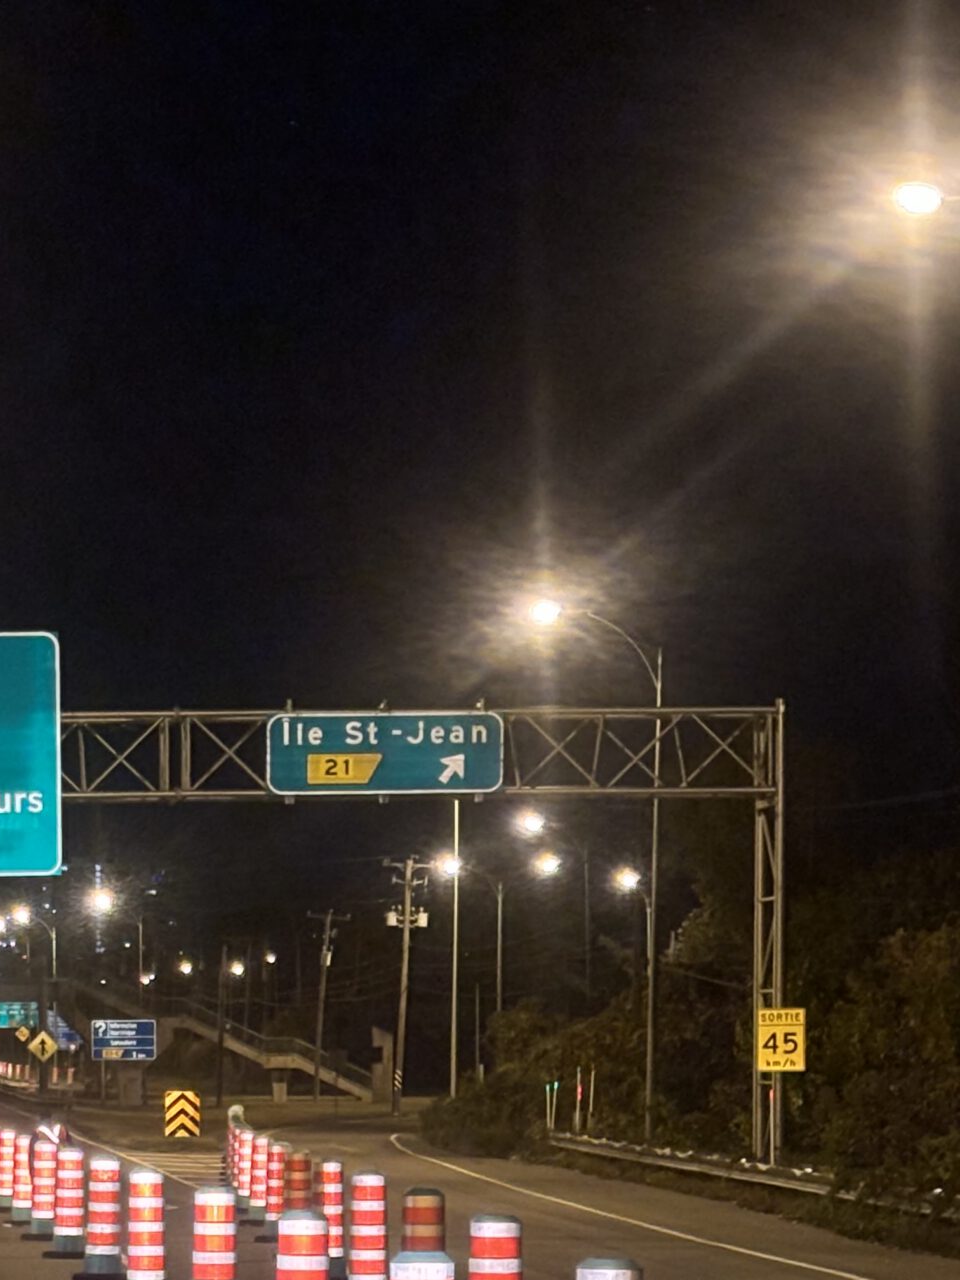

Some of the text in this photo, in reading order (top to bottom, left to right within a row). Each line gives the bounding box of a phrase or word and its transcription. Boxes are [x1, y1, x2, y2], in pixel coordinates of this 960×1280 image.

[324, 759, 352, 776] 21
[760, 1012, 801, 1023] SORTIE
[762, 1032, 798, 1054] 45
[766, 1058, 796, 1067] km/h
